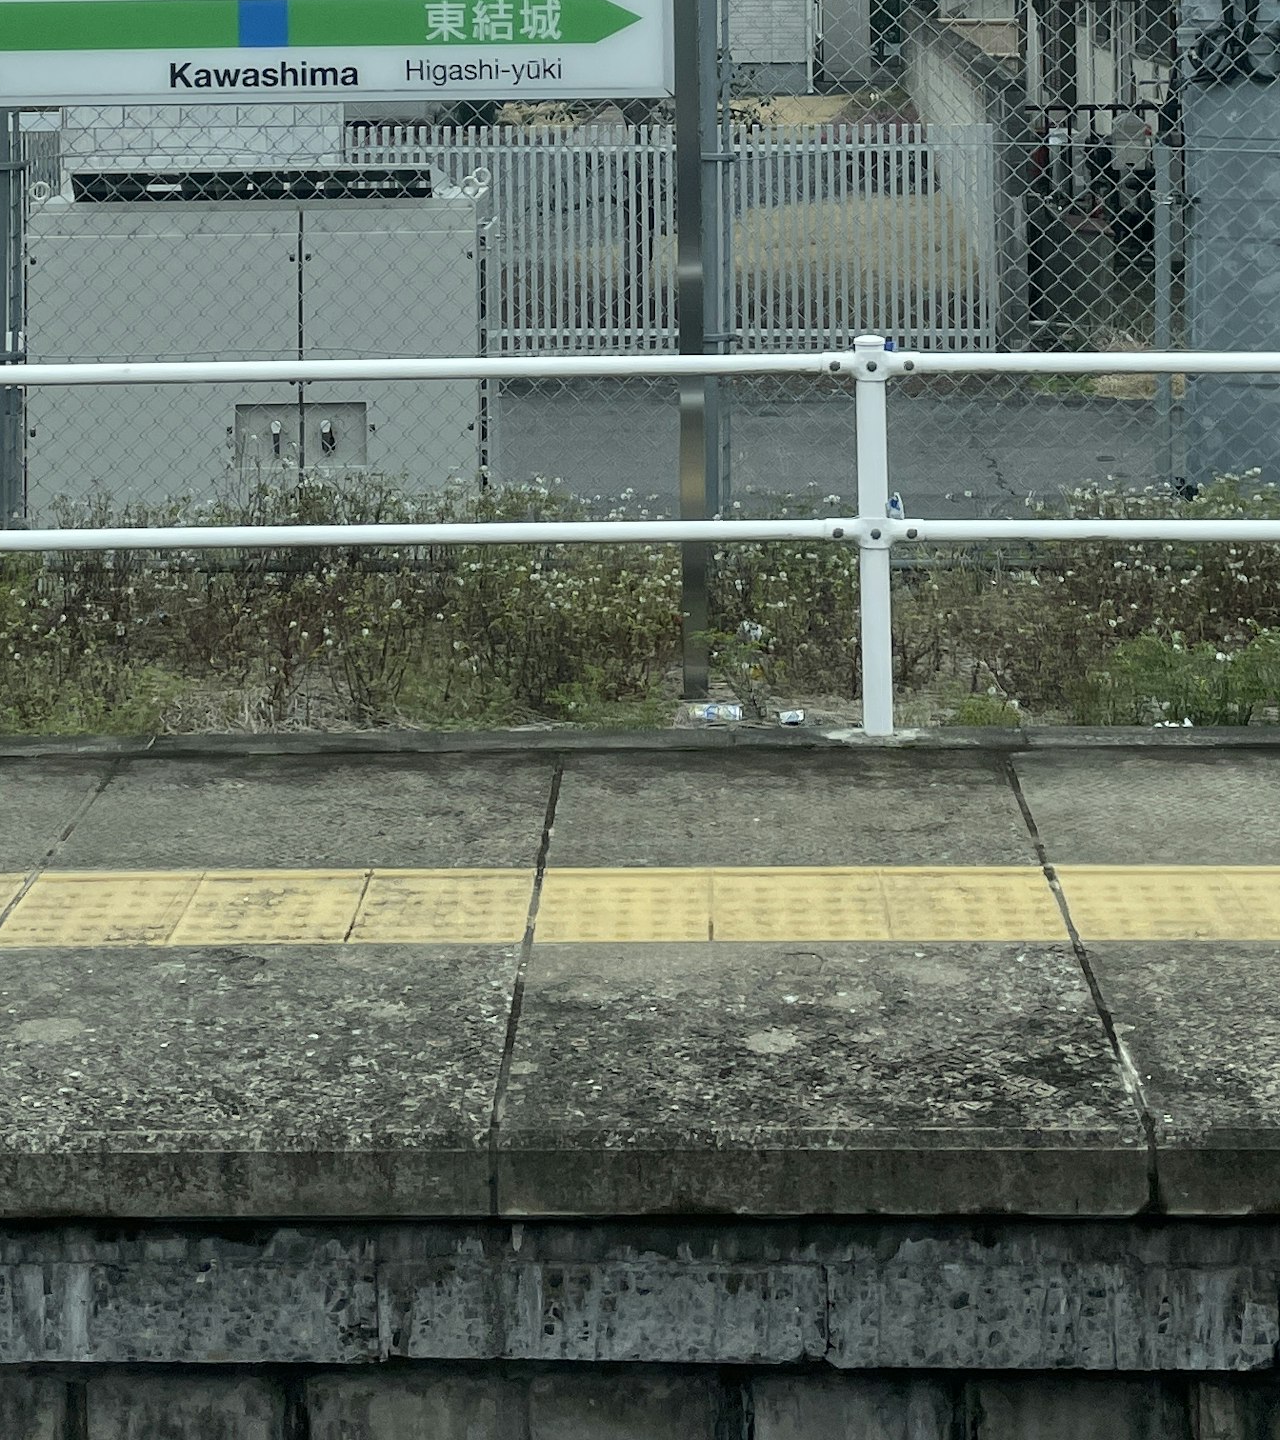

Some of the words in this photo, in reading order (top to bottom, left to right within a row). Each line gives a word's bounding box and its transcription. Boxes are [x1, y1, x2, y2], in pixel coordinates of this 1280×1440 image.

[424, 0, 563, 42] 東結城
[169, 61, 359, 88] Kawashima
[405, 57, 563, 87] Higashi-yūki
